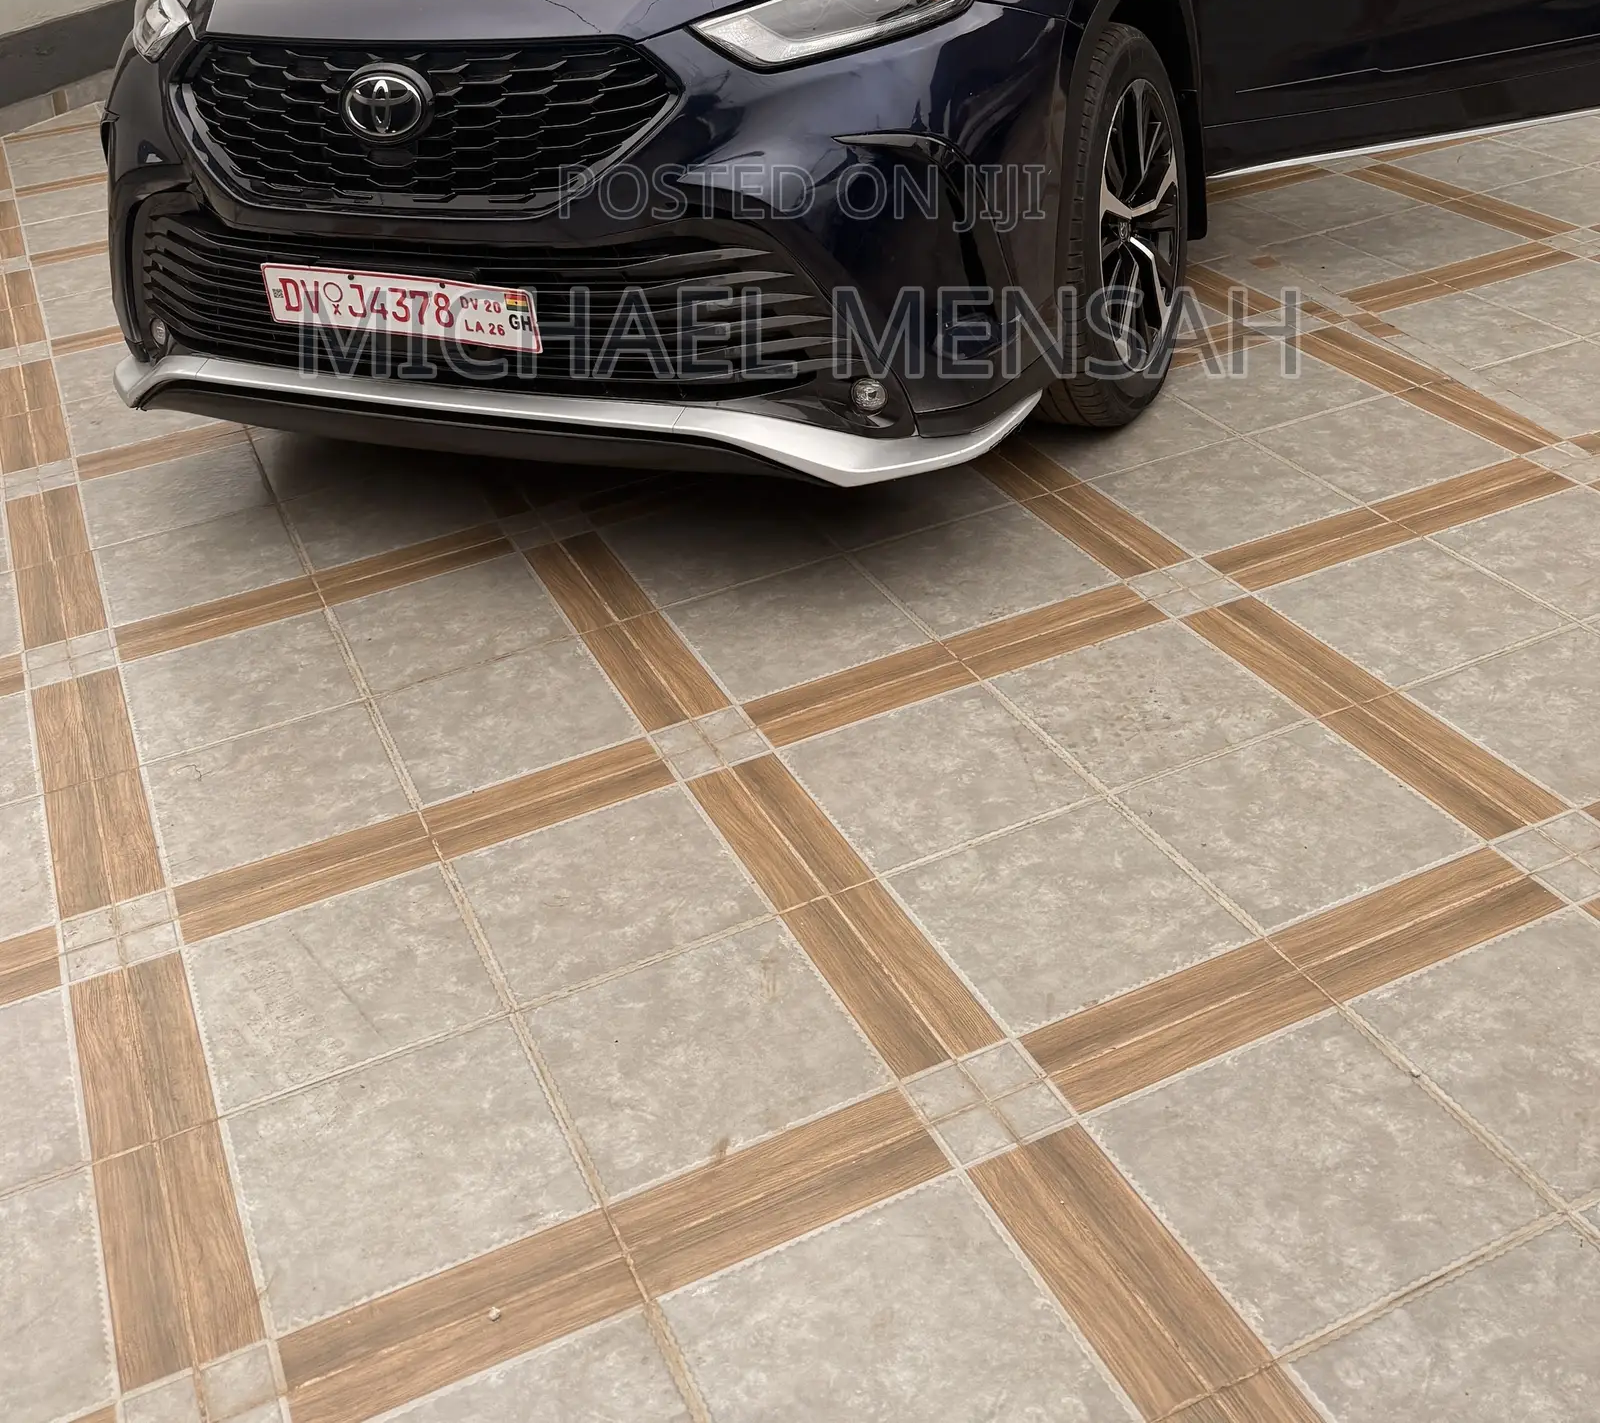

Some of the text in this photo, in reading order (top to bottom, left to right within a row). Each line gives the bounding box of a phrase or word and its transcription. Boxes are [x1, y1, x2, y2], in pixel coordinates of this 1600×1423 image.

[460, 295, 501, 314] DV 20
[465, 319, 506, 337] LA 26
[508, 313, 533, 332] GH
